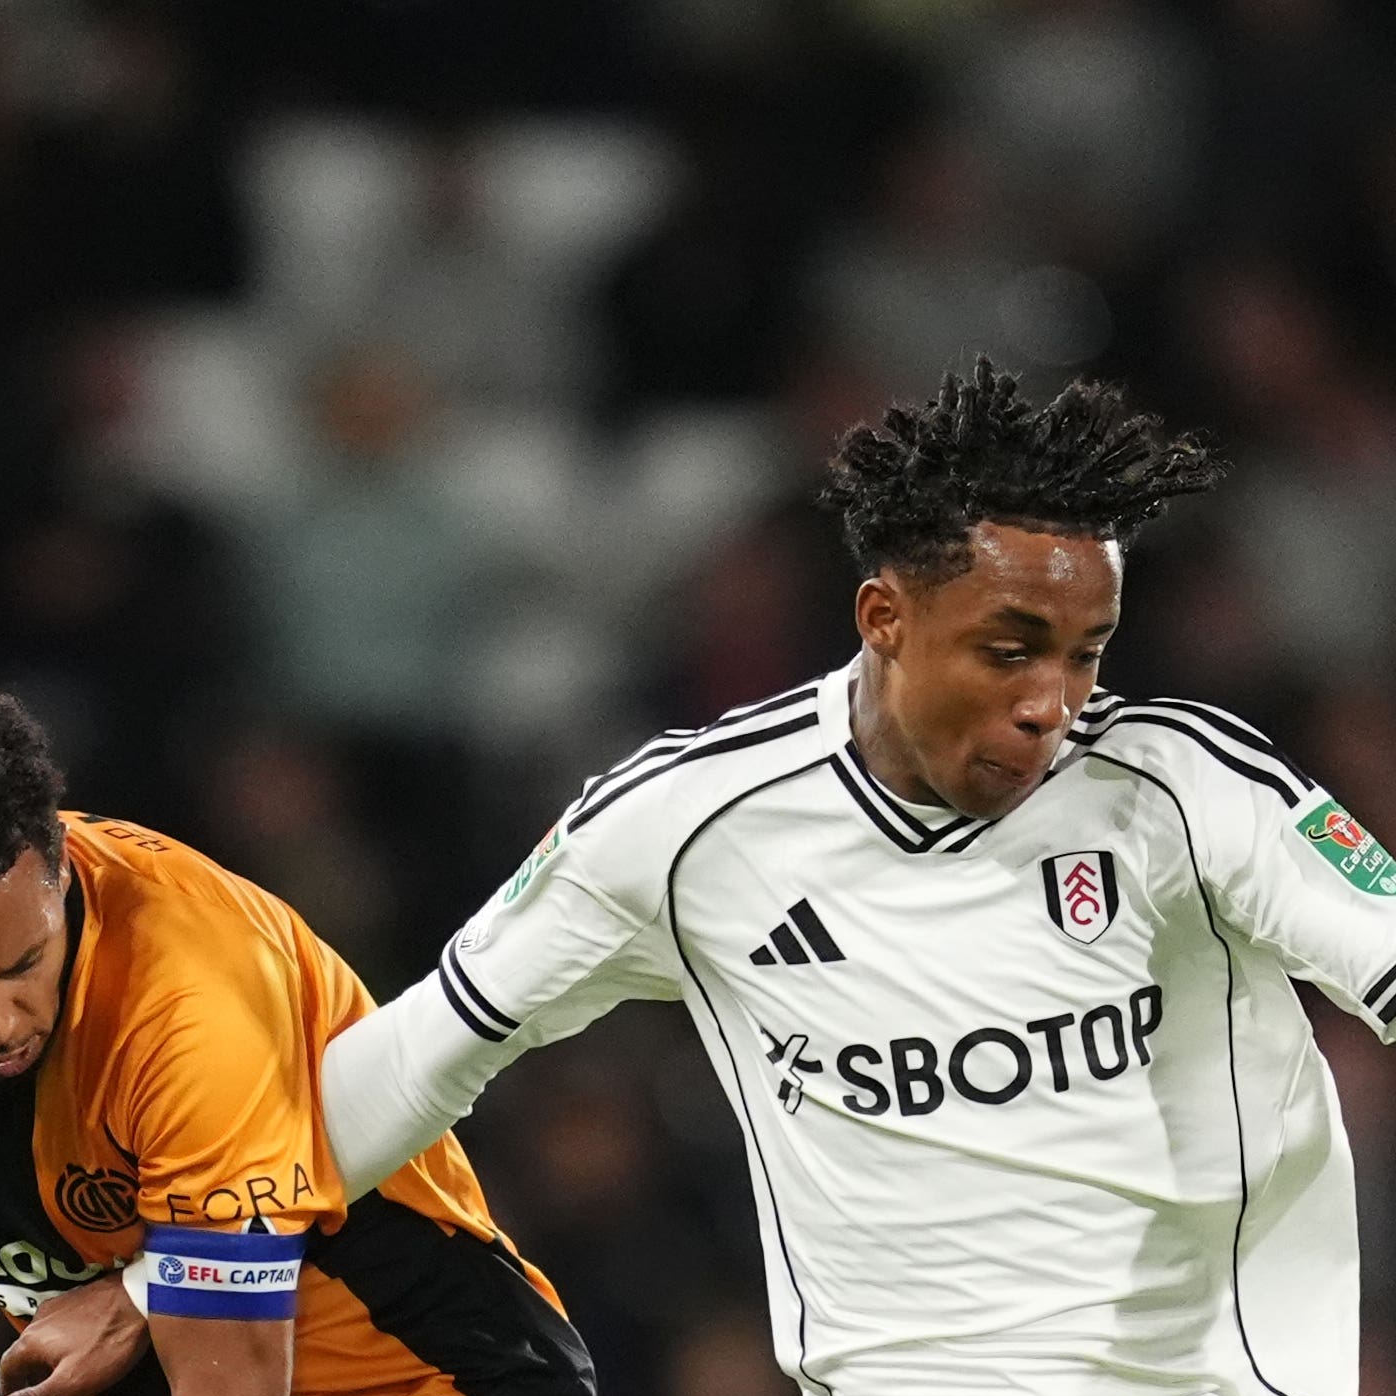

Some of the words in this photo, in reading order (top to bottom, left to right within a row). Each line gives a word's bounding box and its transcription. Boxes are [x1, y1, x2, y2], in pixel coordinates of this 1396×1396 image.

[1340, 833, 1376, 873] Caraba
[1362, 850, 1384, 873] Cup
[1063, 860, 1100, 926] FFC
[836, 984, 1163, 1117] SBOTOP
[166, 1162, 314, 1224] FORA
[187, 1265, 224, 1284] EFL
[229, 1267, 296, 1285] CAPTAIN
